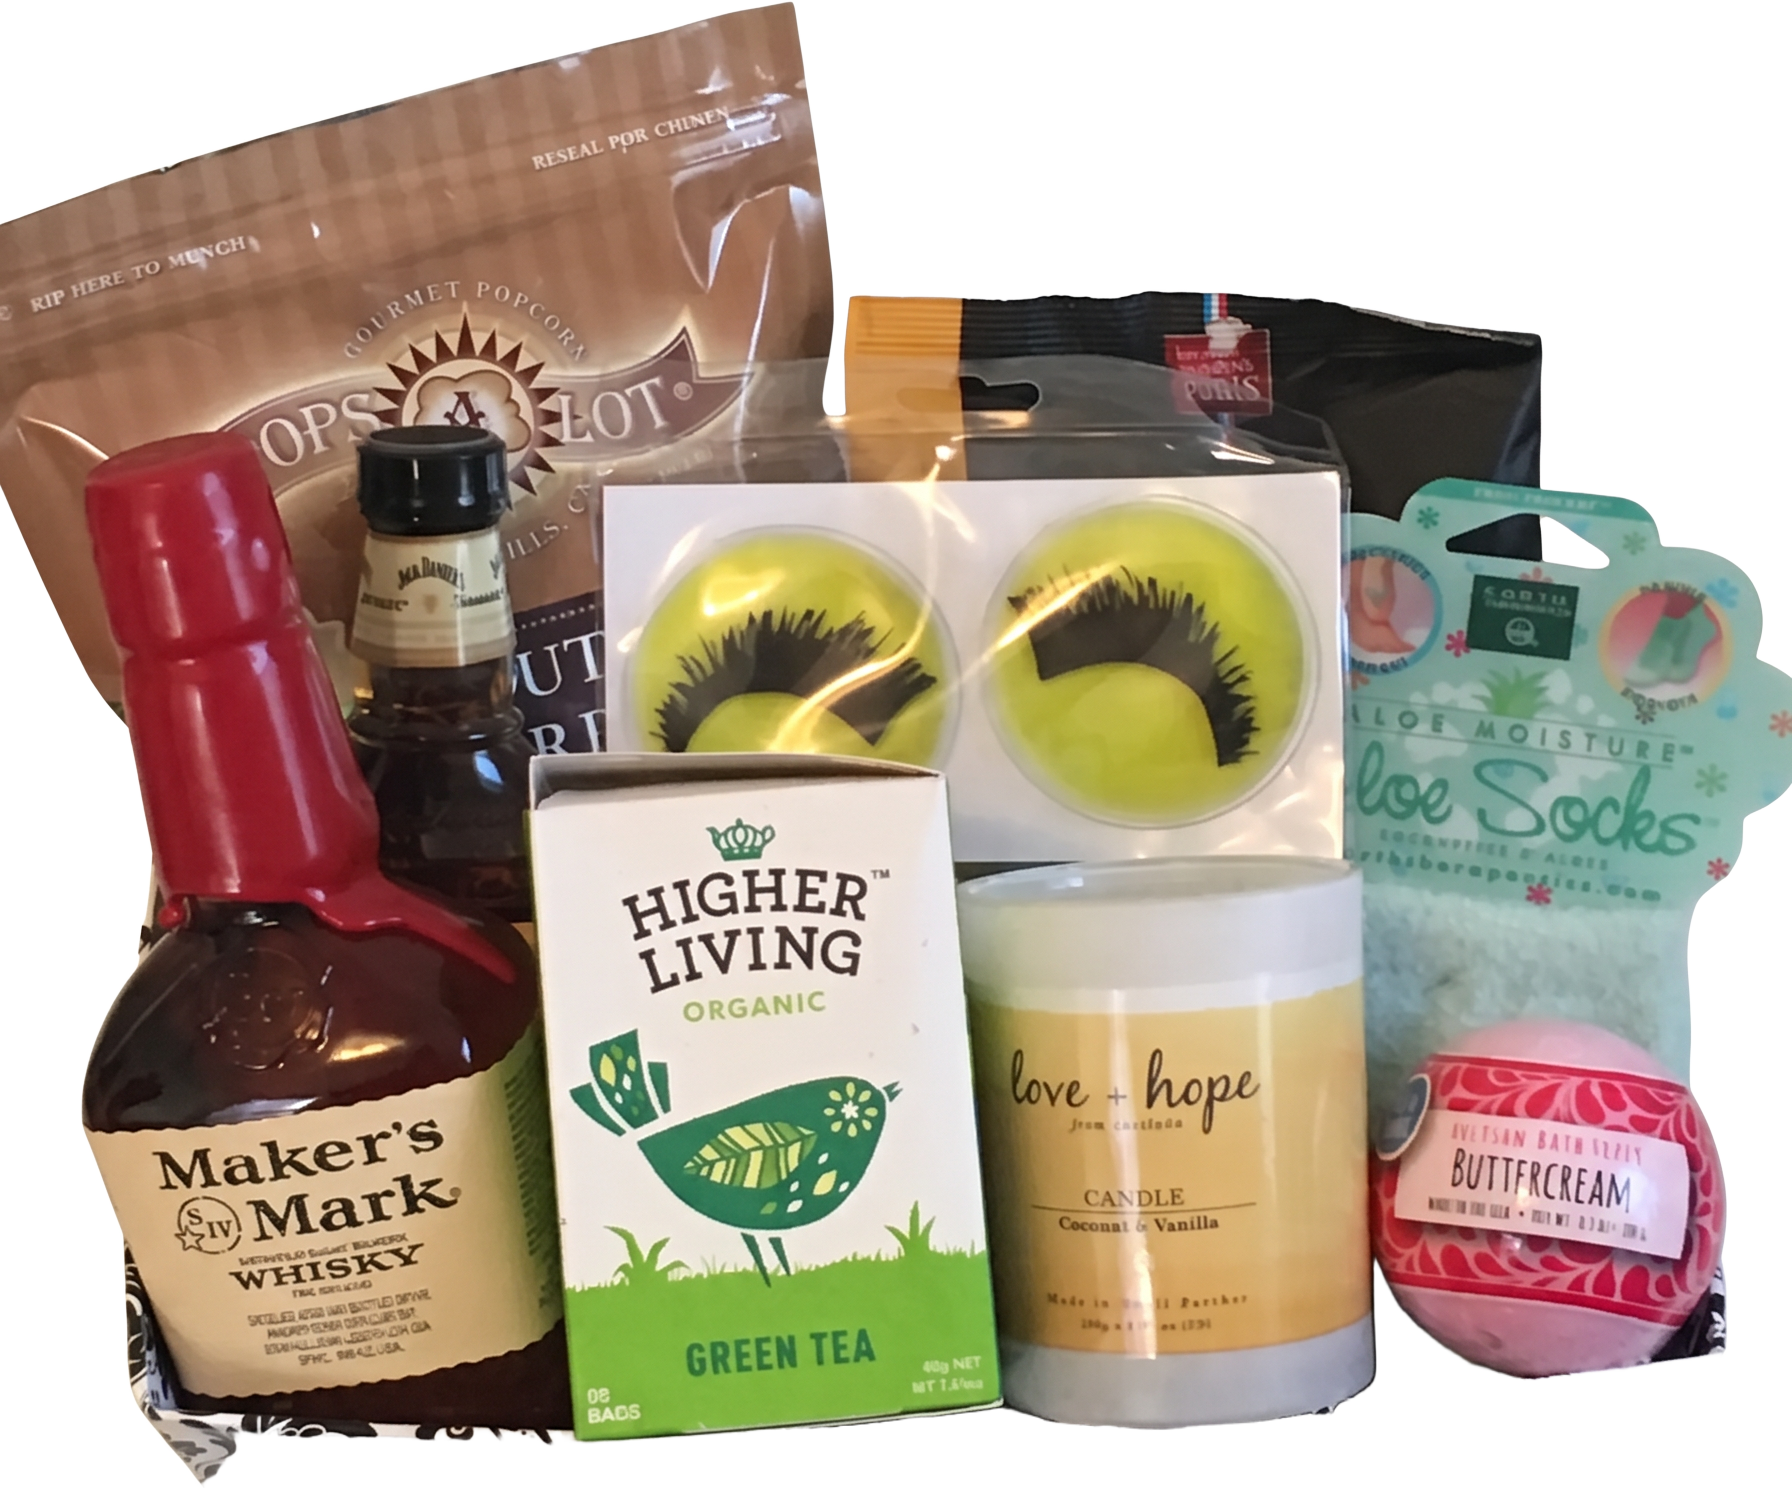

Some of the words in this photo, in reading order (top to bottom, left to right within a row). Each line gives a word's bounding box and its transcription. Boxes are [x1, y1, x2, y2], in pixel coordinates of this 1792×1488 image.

[531, 141, 604, 171] RESEAL
[30, 289, 66, 313] RIP
[71, 270, 125, 298] HERE
[131, 259, 161, 280] TO
[343, 280, 461, 360] GOURMET
[251, 393, 382, 467] OPS
[559, 375, 670, 443] LOT
[1475, 719, 1675, 763] MOISTURE
[1356, 740, 1453, 826] loe
[1473, 757, 1702, 857] Socks
[621, 868, 868, 941] HIGHER
[638, 926, 862, 994] LIVING
[683, 991, 827, 1023] ORGANIC
[1011, 1048, 1090, 1109] love
[1145, 1048, 1261, 1135] hope
[152, 1118, 445, 1191] Maker's
[1537, 1129, 1583, 1155] BATH
[246, 1173, 458, 1242] Mark
[1084, 1188, 1185, 1208] CANDLE
[1154, 1214, 1220, 1232] Vanilla
[228, 1242, 425, 1291] WHISKY
[686, 1335, 798, 1377] GREEN
[810, 1328, 876, 1366] TEA
